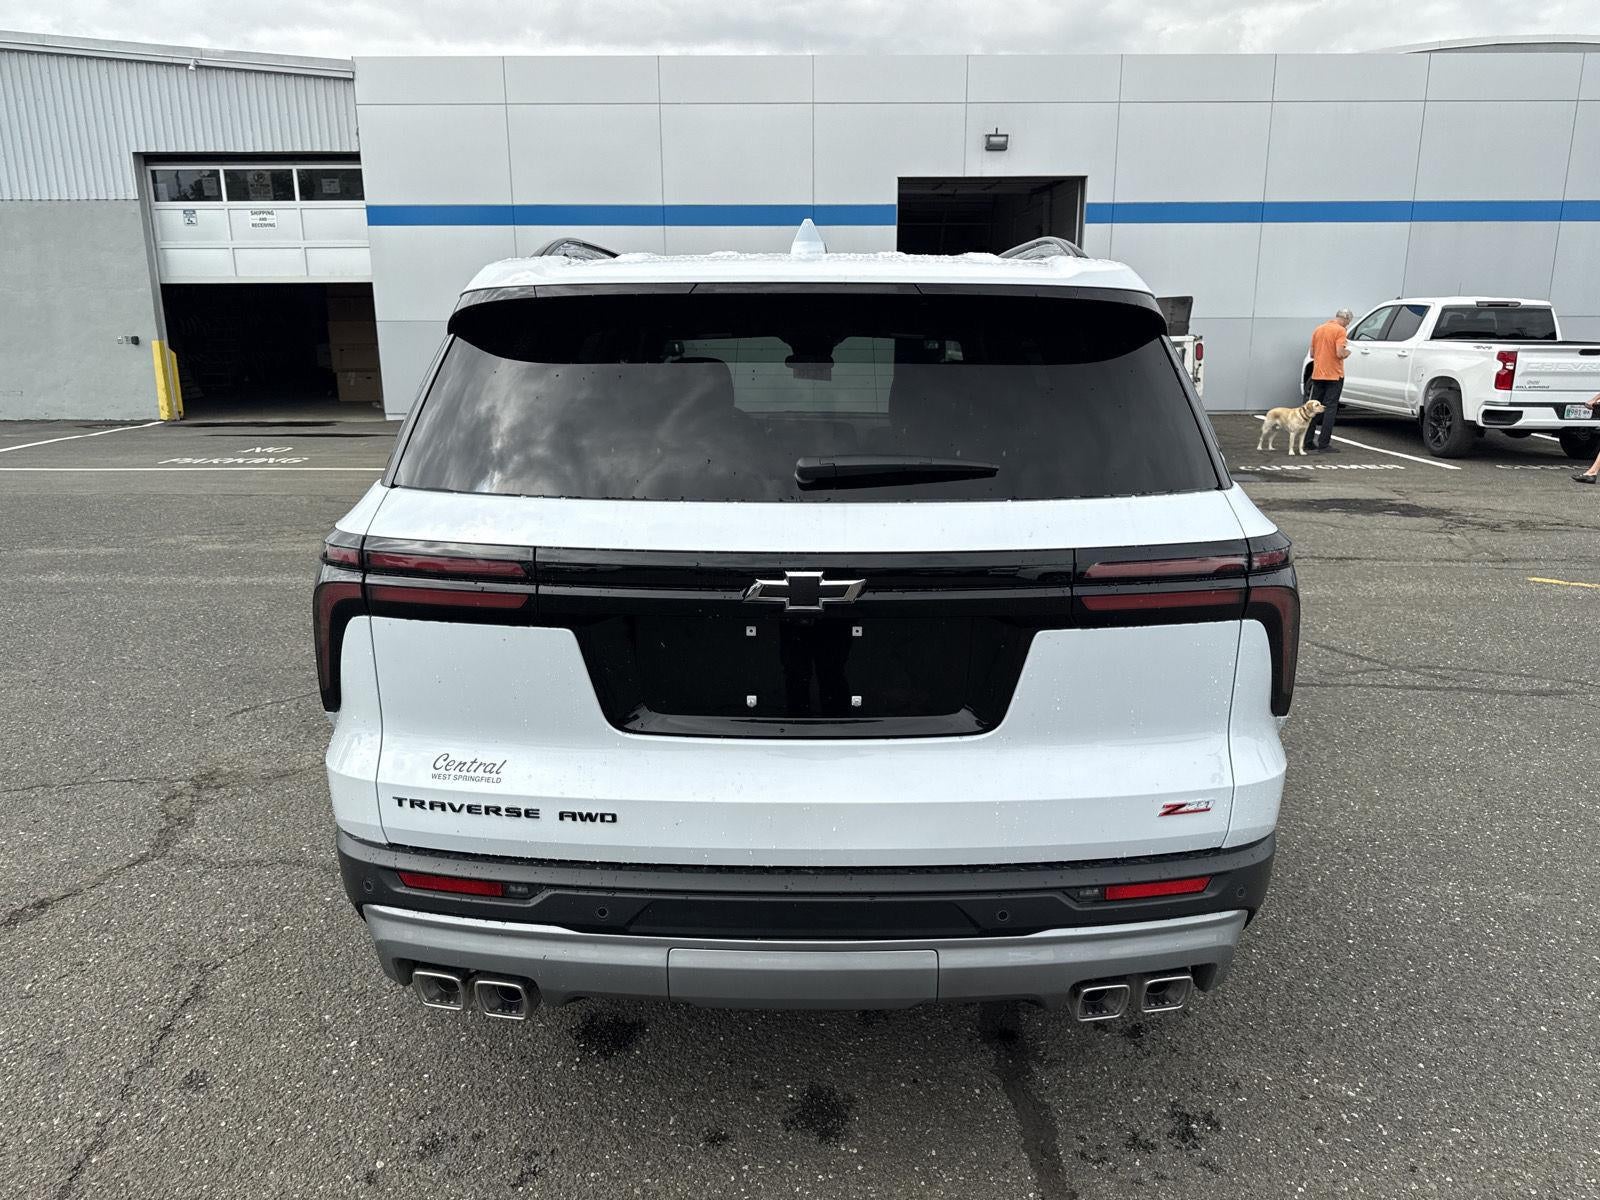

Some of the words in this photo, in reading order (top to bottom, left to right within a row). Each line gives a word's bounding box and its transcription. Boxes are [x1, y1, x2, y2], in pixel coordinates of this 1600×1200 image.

[157, 457, 309, 465] PARKING
[432, 752, 507, 776] Central
[431, 773, 452, 781] WEST
[453, 774, 502, 784] SPRINGFIELD
[392, 796, 541, 819] TRAVERSE
[558, 810, 618, 823] AWD
